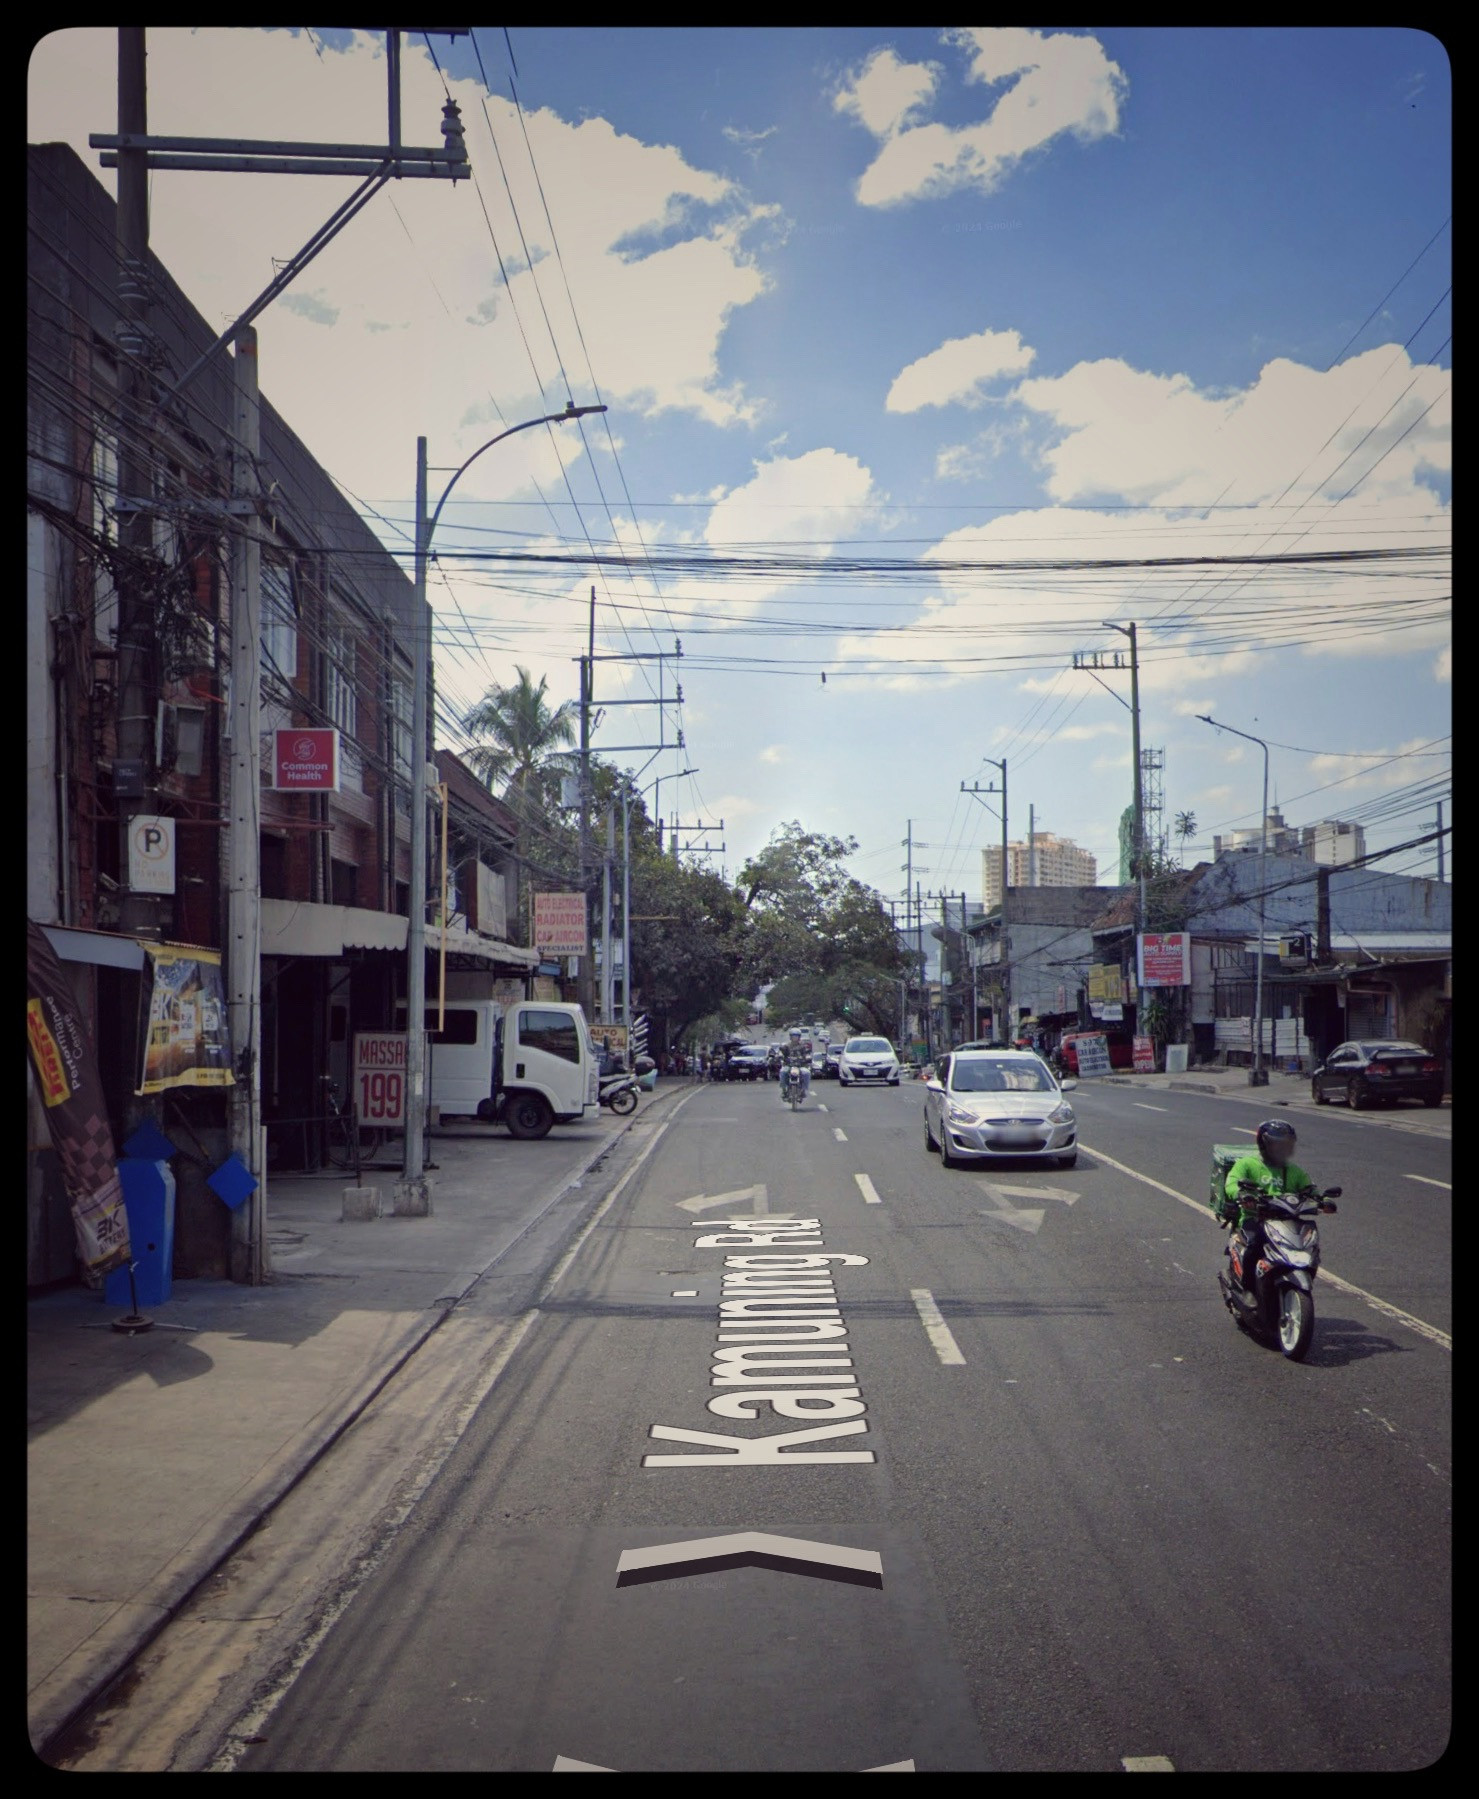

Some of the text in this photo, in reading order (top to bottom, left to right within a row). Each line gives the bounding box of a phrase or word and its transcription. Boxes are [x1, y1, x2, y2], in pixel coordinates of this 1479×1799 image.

[281, 761, 328, 771] Common
[287, 771, 322, 780] Health
[536, 913, 584, 926] RADIATOR
[555, 930, 585, 942] AIRCON
[1144, 943, 1183, 952] BIG TIME
[590, 1028, 618, 1037] AUTO
[46, 996, 81, 1091] Performance
[359, 1040, 408, 1065] MASSA
[360, 1072, 402, 1119] 199
